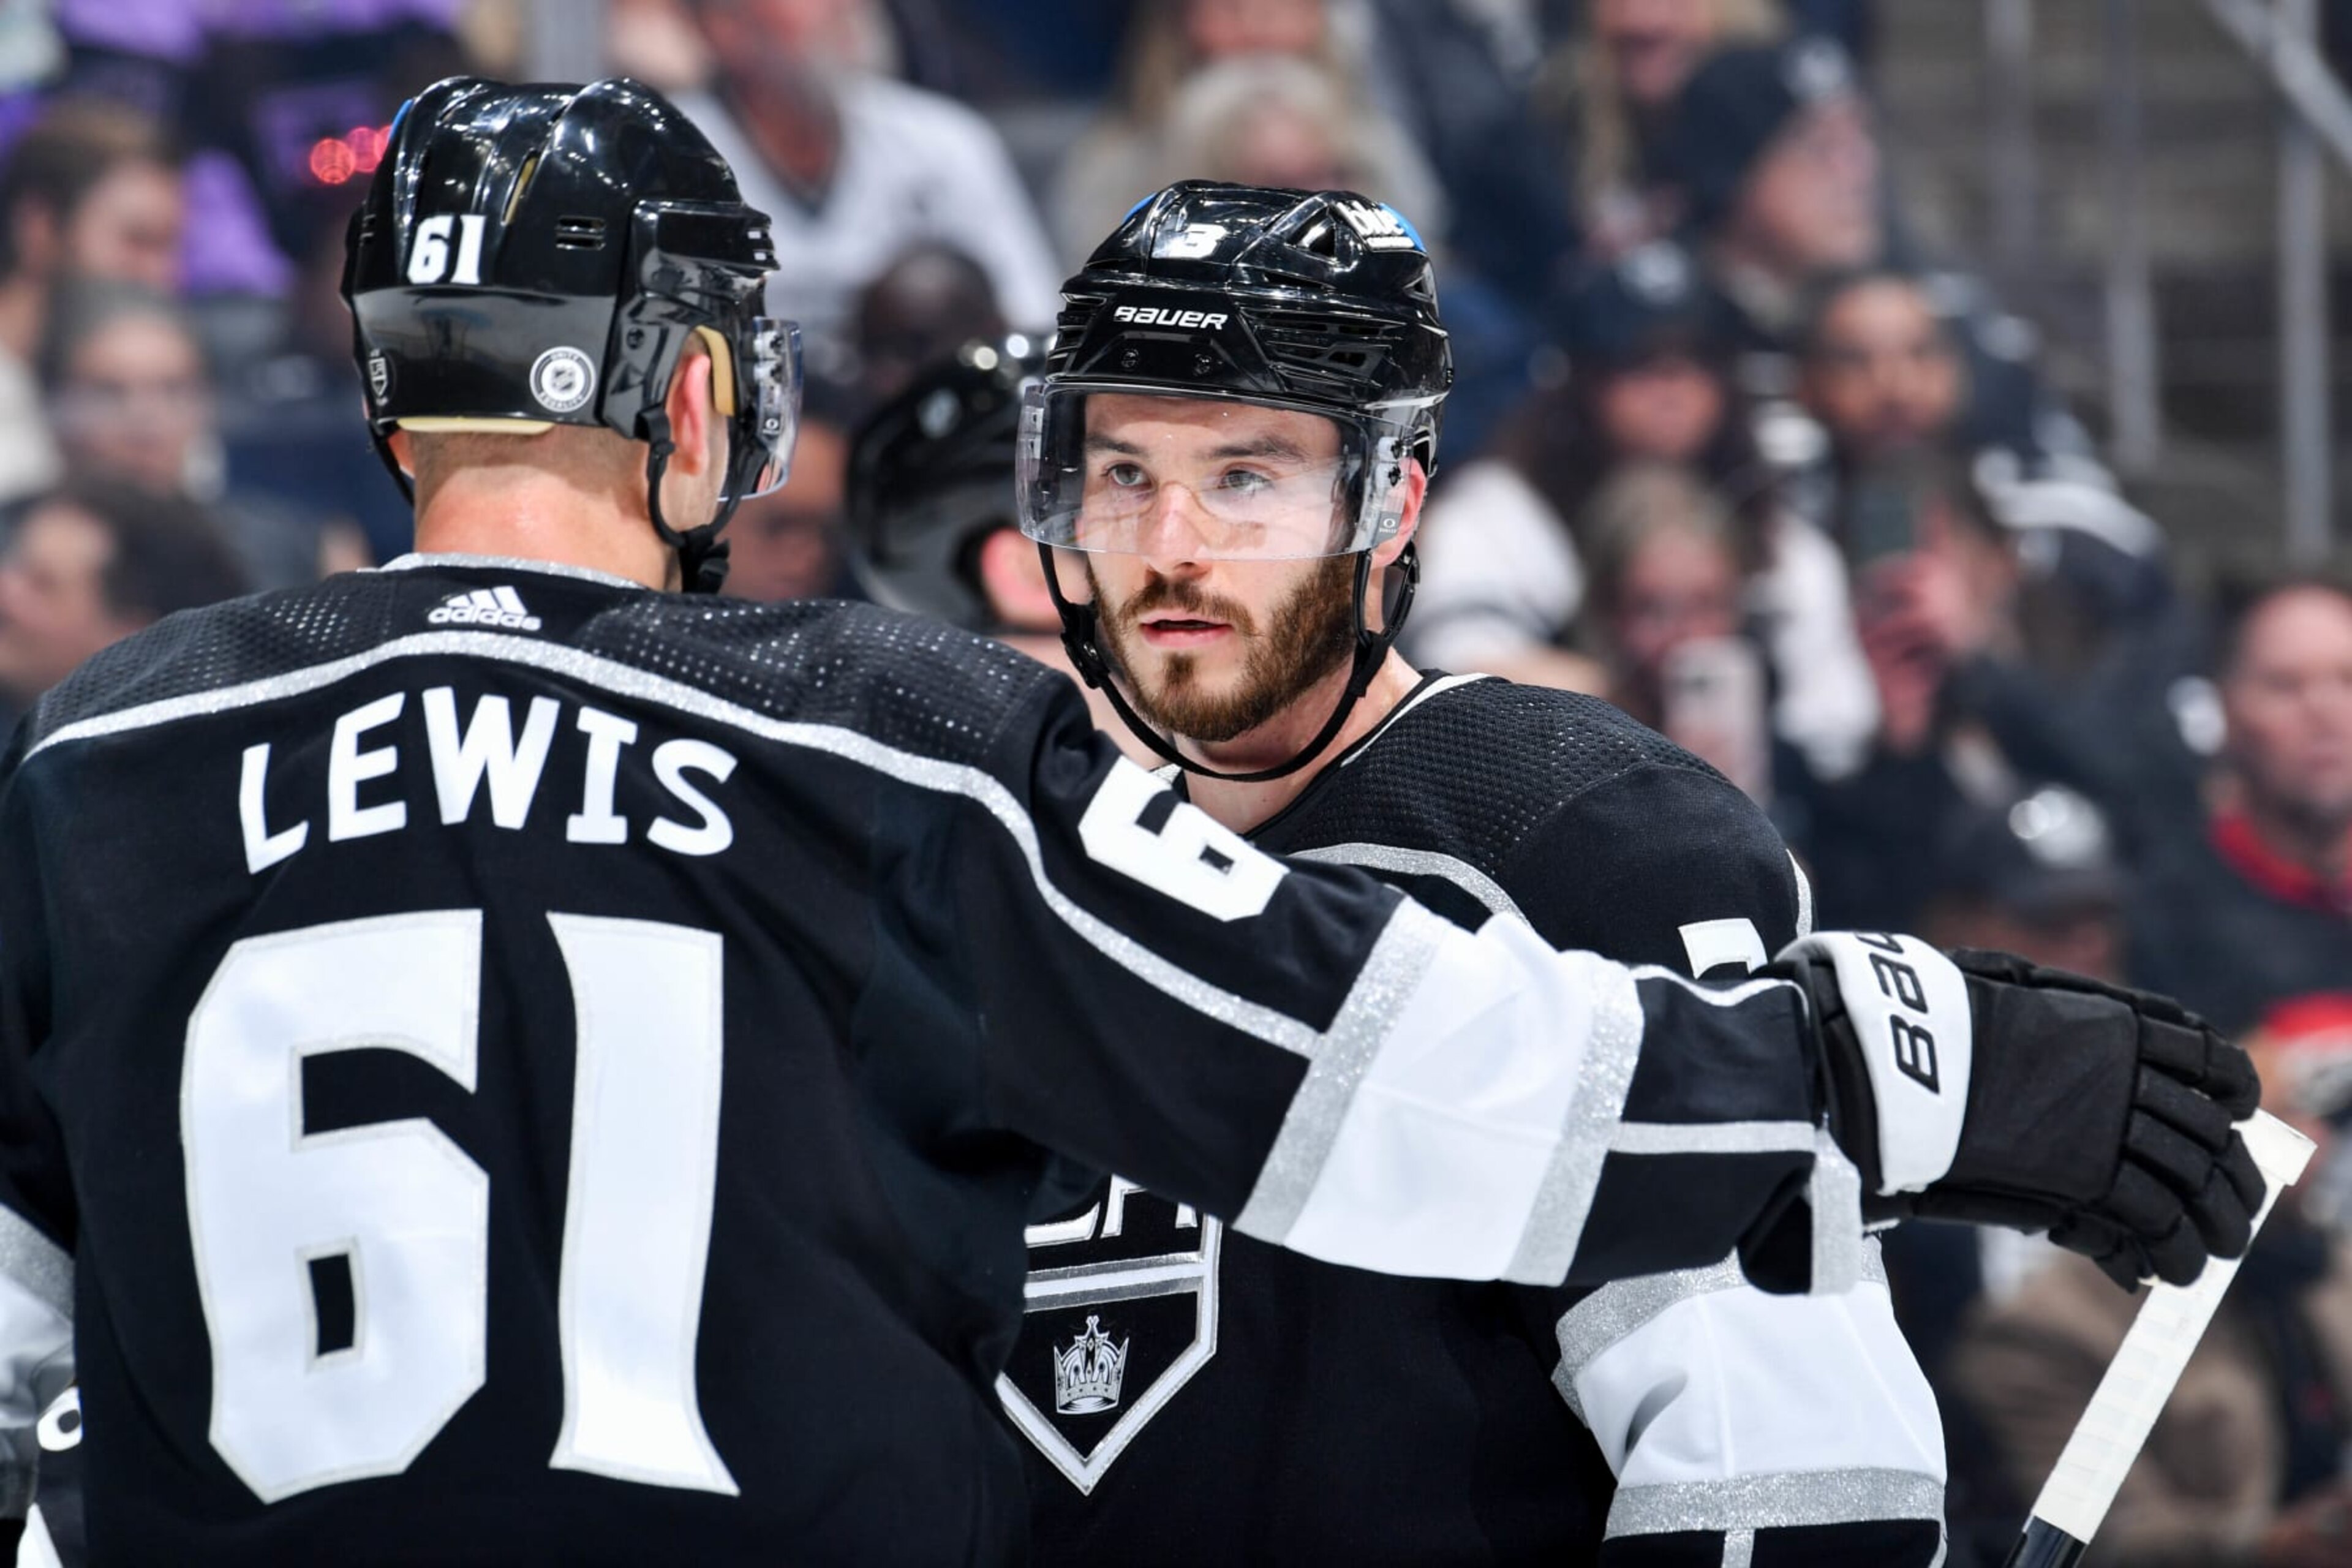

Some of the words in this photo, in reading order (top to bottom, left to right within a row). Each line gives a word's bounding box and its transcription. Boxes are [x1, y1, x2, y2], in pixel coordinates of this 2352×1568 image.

[407, 214, 486, 285] 61
[428, 604, 541, 631] adidas
[239, 685, 738, 875] LEWIS
[179, 908, 740, 1506] 61
